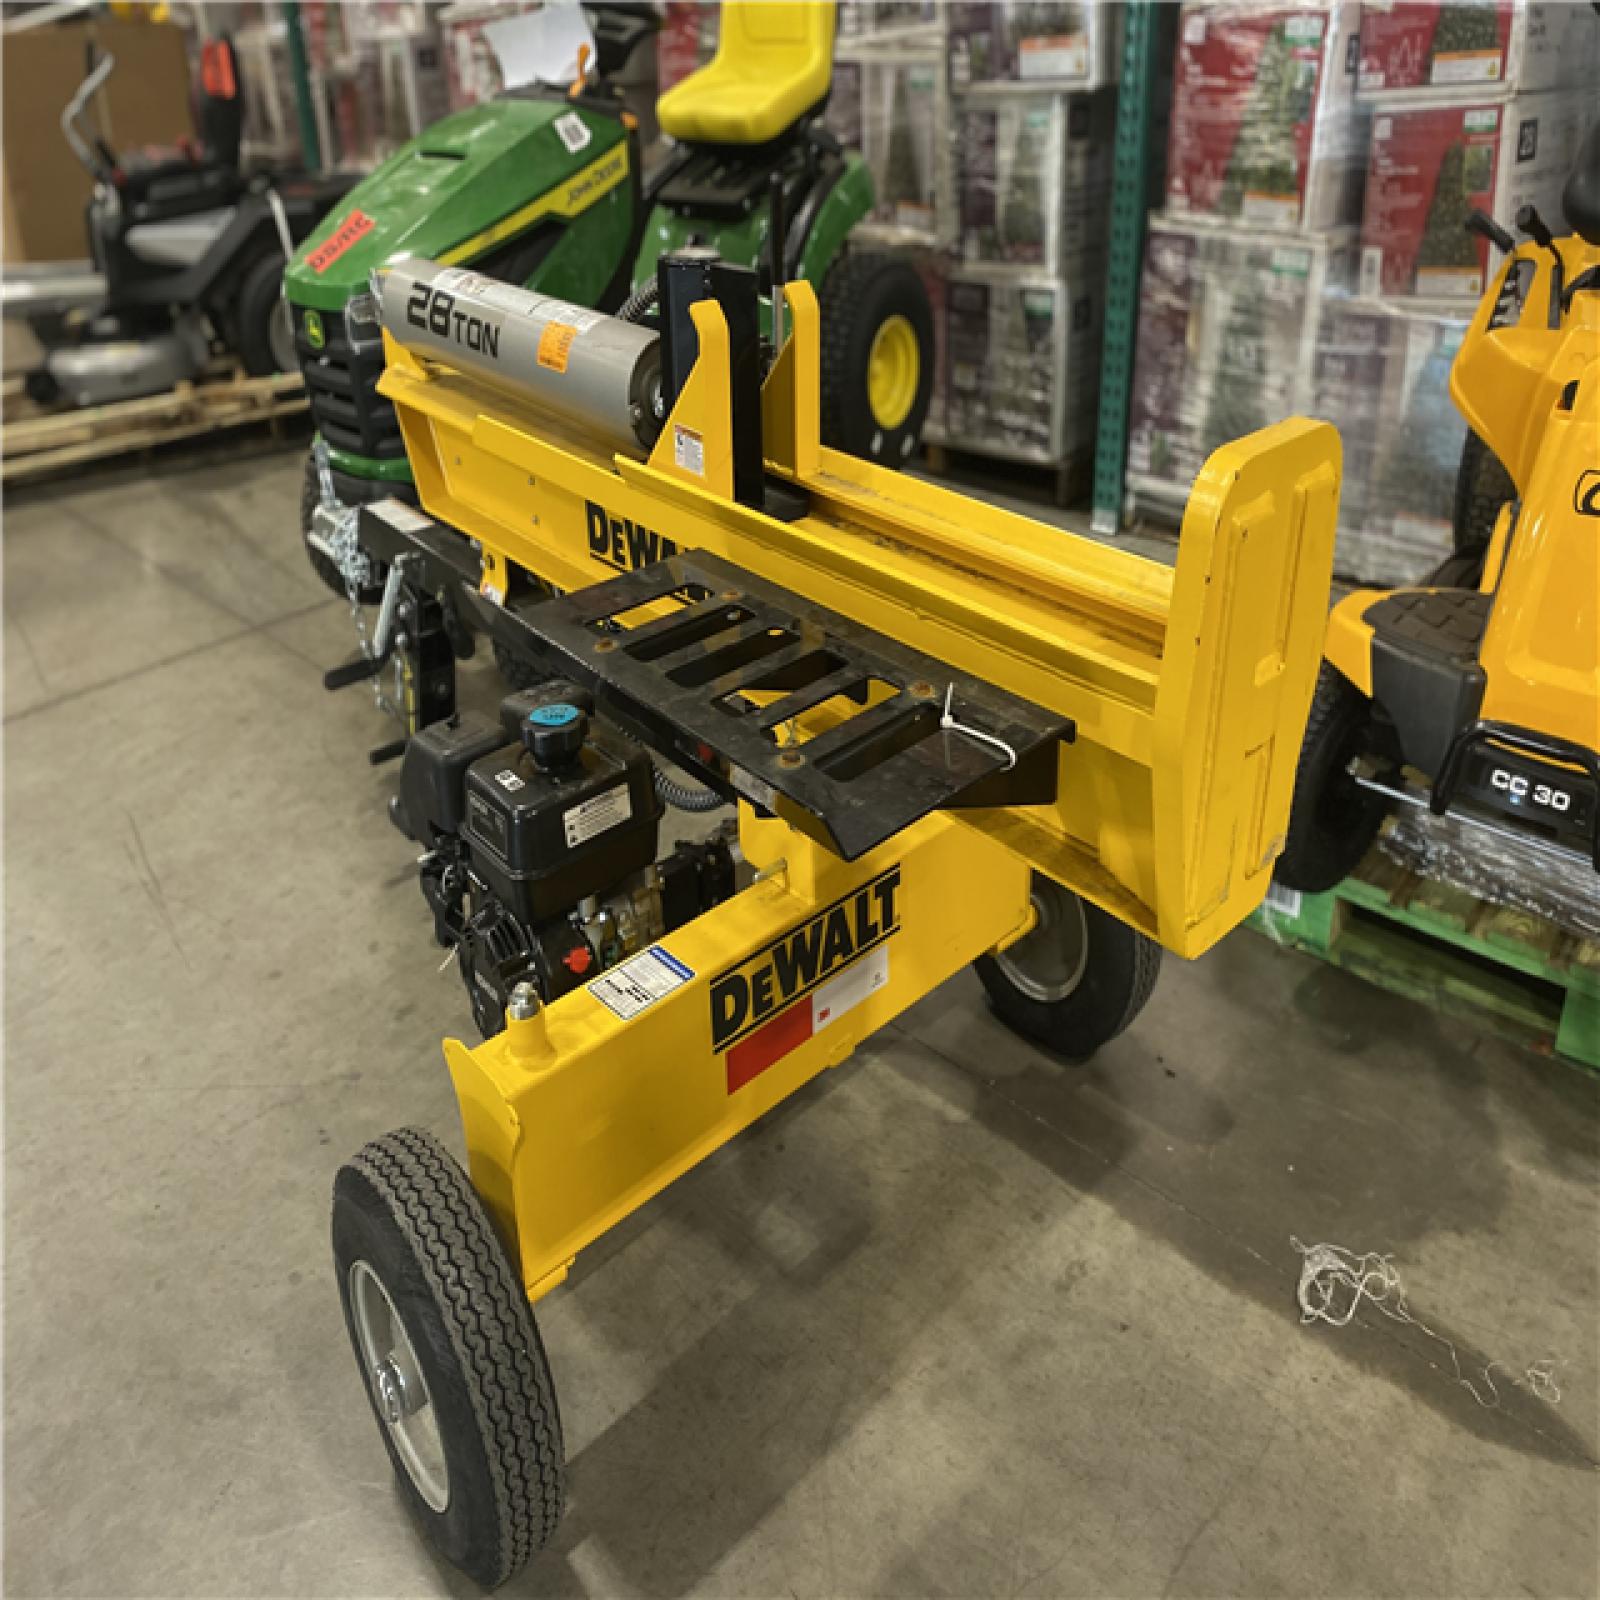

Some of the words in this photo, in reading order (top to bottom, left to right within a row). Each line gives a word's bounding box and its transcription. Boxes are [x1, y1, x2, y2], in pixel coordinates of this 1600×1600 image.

[1491, 769, 1528, 795] CC
[1533, 785, 1570, 811] 30
[710, 872, 901, 1047] DEWALT
